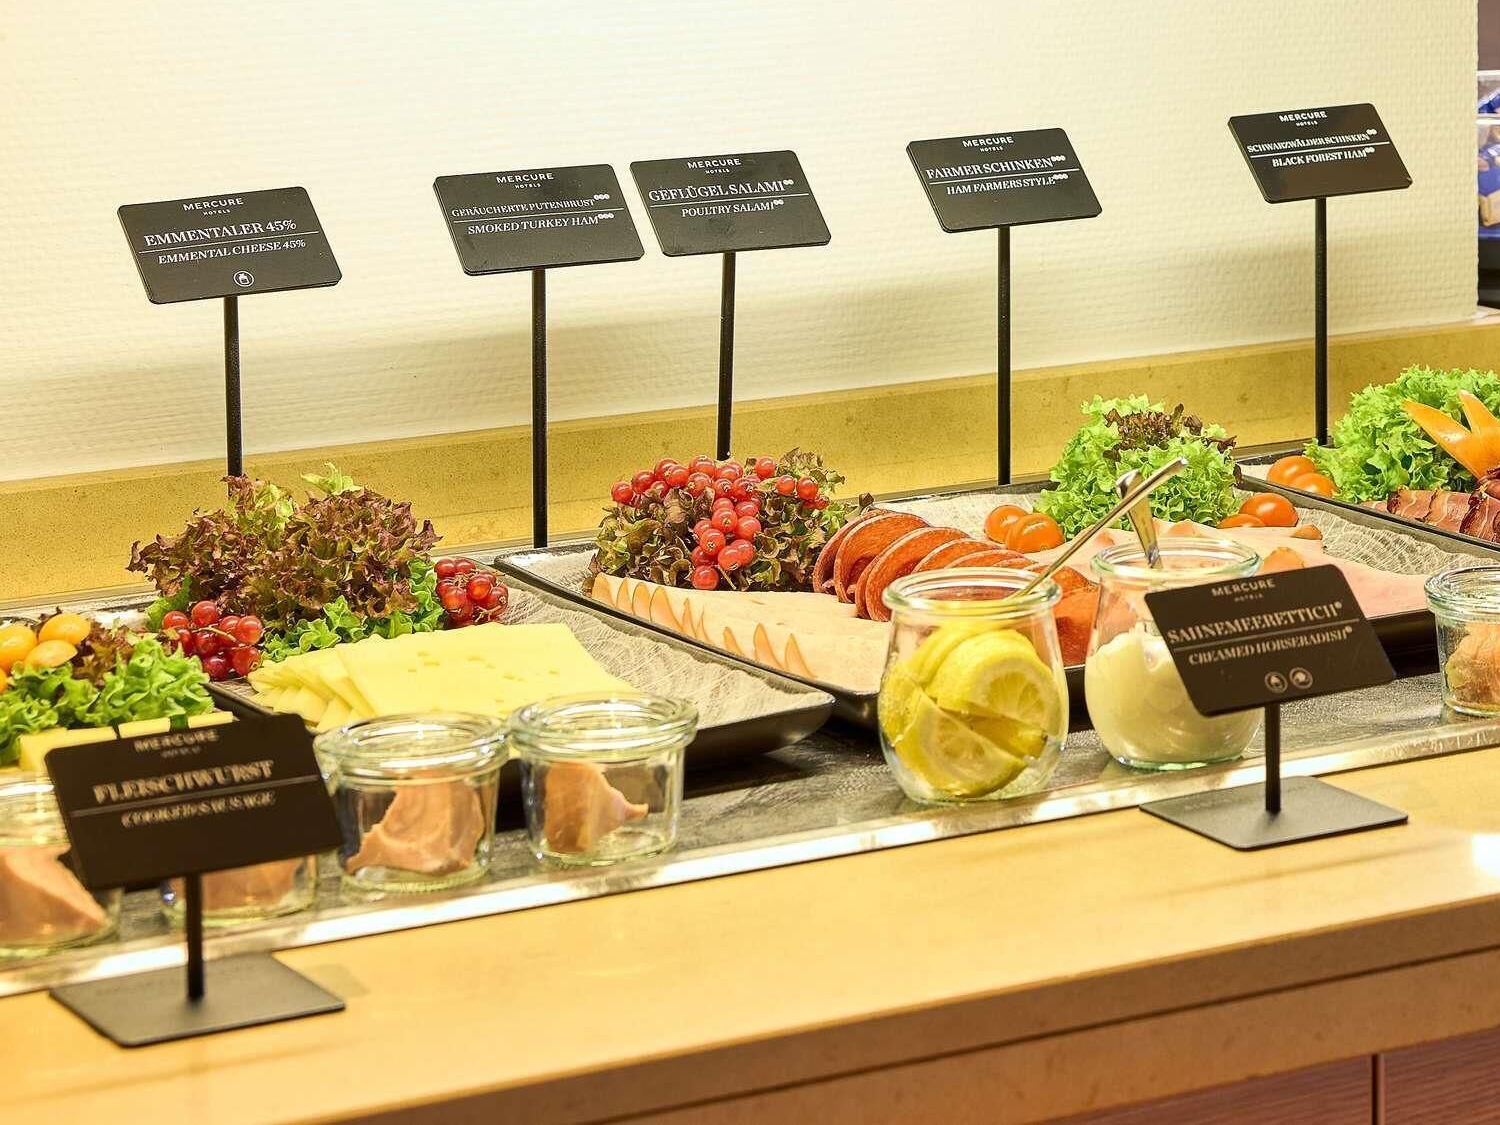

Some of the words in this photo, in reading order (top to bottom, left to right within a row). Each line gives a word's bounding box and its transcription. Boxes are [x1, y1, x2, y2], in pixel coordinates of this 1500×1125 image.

[1278, 110, 1328, 123] MERCURE
[962, 135, 1014, 148] MERCURE
[687, 158, 742, 169] MERCURE
[1272, 155, 1305, 167] BLACK
[1306, 151, 1343, 164] FOREST
[1344, 148, 1367, 159] HAM
[496, 172, 554, 184] MERCURE
[946, 185, 972, 195] HAM
[973, 178, 1022, 192] FARMERS
[648, 185, 729, 201] GEFLÜGEL
[729, 180, 785, 195] SALAMI
[183, 197, 244, 211] MERCURE
[203, 208, 231, 216] HOTELS
[451, 202, 528, 217] GERÄUCHERTE
[529, 198, 595, 211] PUTENBRUST
[681, 204, 732, 217] POULTRY
[733, 201, 775, 213] SALAMI
[143, 222, 265, 247] EMMENTALER
[266, 219, 297, 233] 45%
[468, 222, 520, 235] SMOKED
[520, 217, 571, 230] TURKEY
[571, 215, 599, 227] HAM
[158, 247, 232, 265] EMMENTAL
[232, 241, 282, 256] CHEESE
[282, 239, 306, 250] 45%
[1212, 578, 1276, 597] MERCURE
[1189, 645, 1255, 666] CREAMED
[1256, 630, 1348, 653] HORSERADISH
[133, 729, 220, 753] MERCURE
[92, 760, 275, 805] FLEISCHWURST
